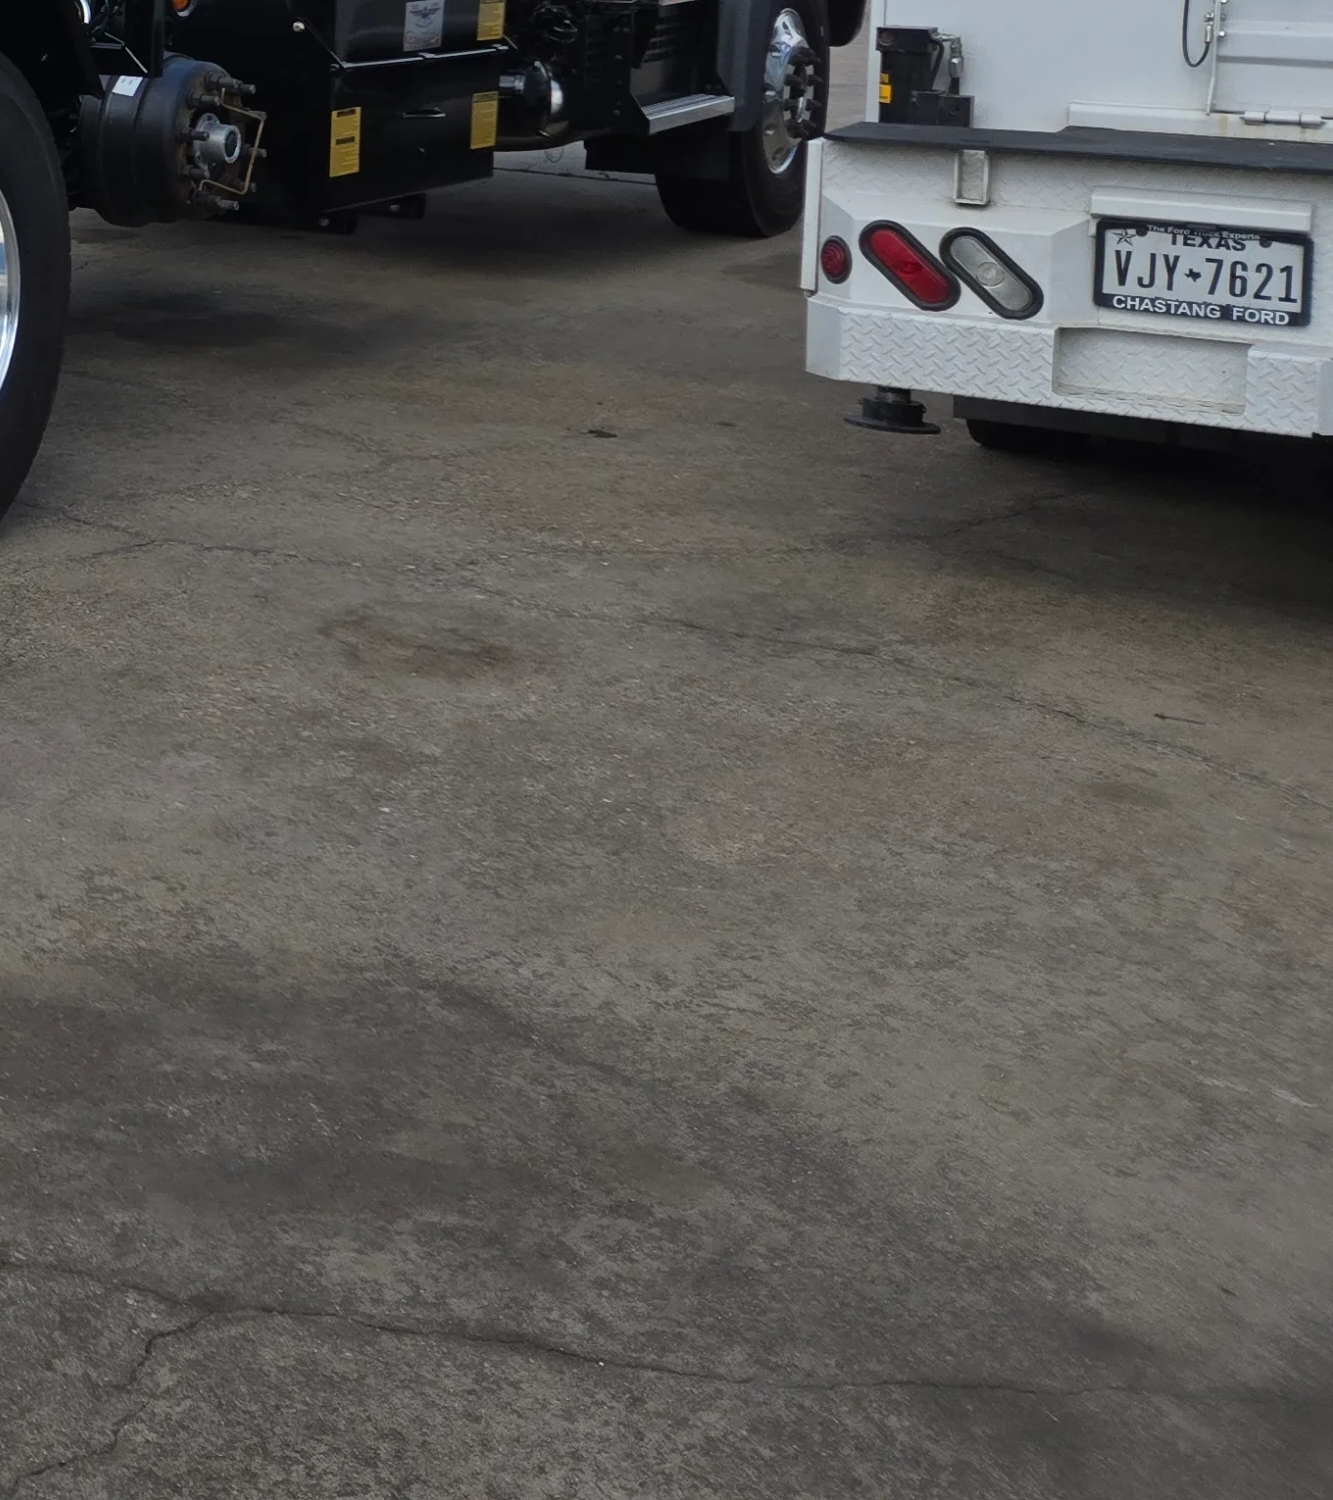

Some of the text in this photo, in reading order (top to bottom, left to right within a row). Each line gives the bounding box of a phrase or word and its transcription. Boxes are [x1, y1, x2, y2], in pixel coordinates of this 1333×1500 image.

[1147, 224, 1165, 233] The
[1222, 231, 1261, 241] Experts
[1171, 233, 1246, 252] TEXAS
[1115, 249, 1298, 304] VJY 7621
[1113, 295, 1290, 325] CHASTANG FORD
